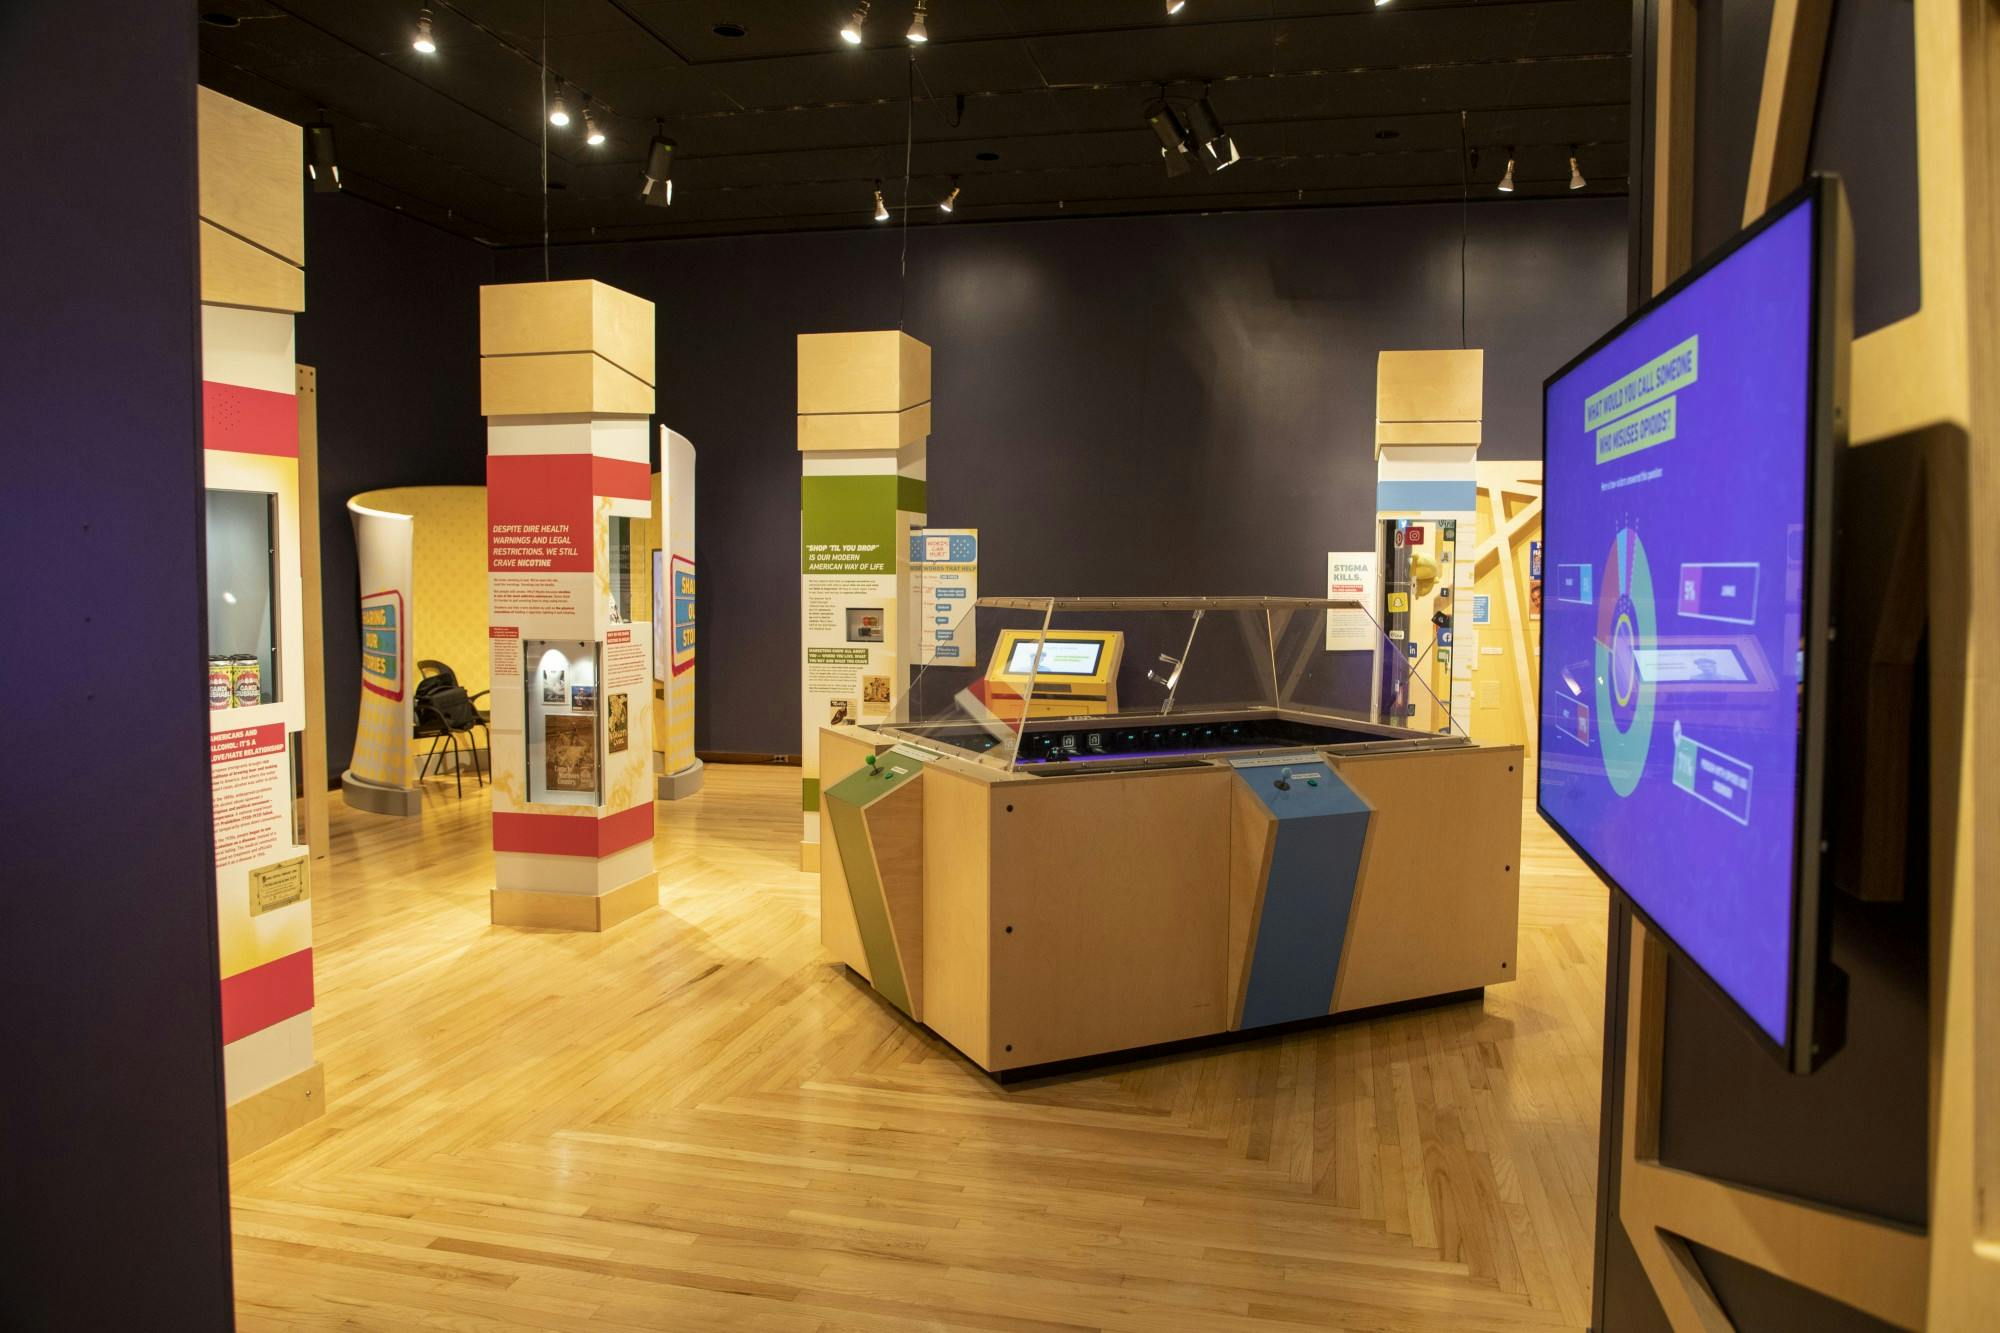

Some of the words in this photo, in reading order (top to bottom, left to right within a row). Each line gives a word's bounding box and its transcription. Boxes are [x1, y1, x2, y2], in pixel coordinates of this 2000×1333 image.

[1588, 400, 1602, 422] WHAT
[1603, 389, 1623, 414] WOULD
[1624, 382, 1636, 402] YOU
[1638, 372, 1654, 397] CALL
[1656, 350, 1692, 388] SOMEONE
[1600, 434, 1612, 454] WHO
[1613, 422, 1638, 448] MISUSES
[1640, 408, 1671, 440] OPIOIDS?
[493, 548, 544, 556] RESTRICTIONS,
[1409, 645, 1416, 655] in
[244, 744, 284, 756] RELATIONSHIP
